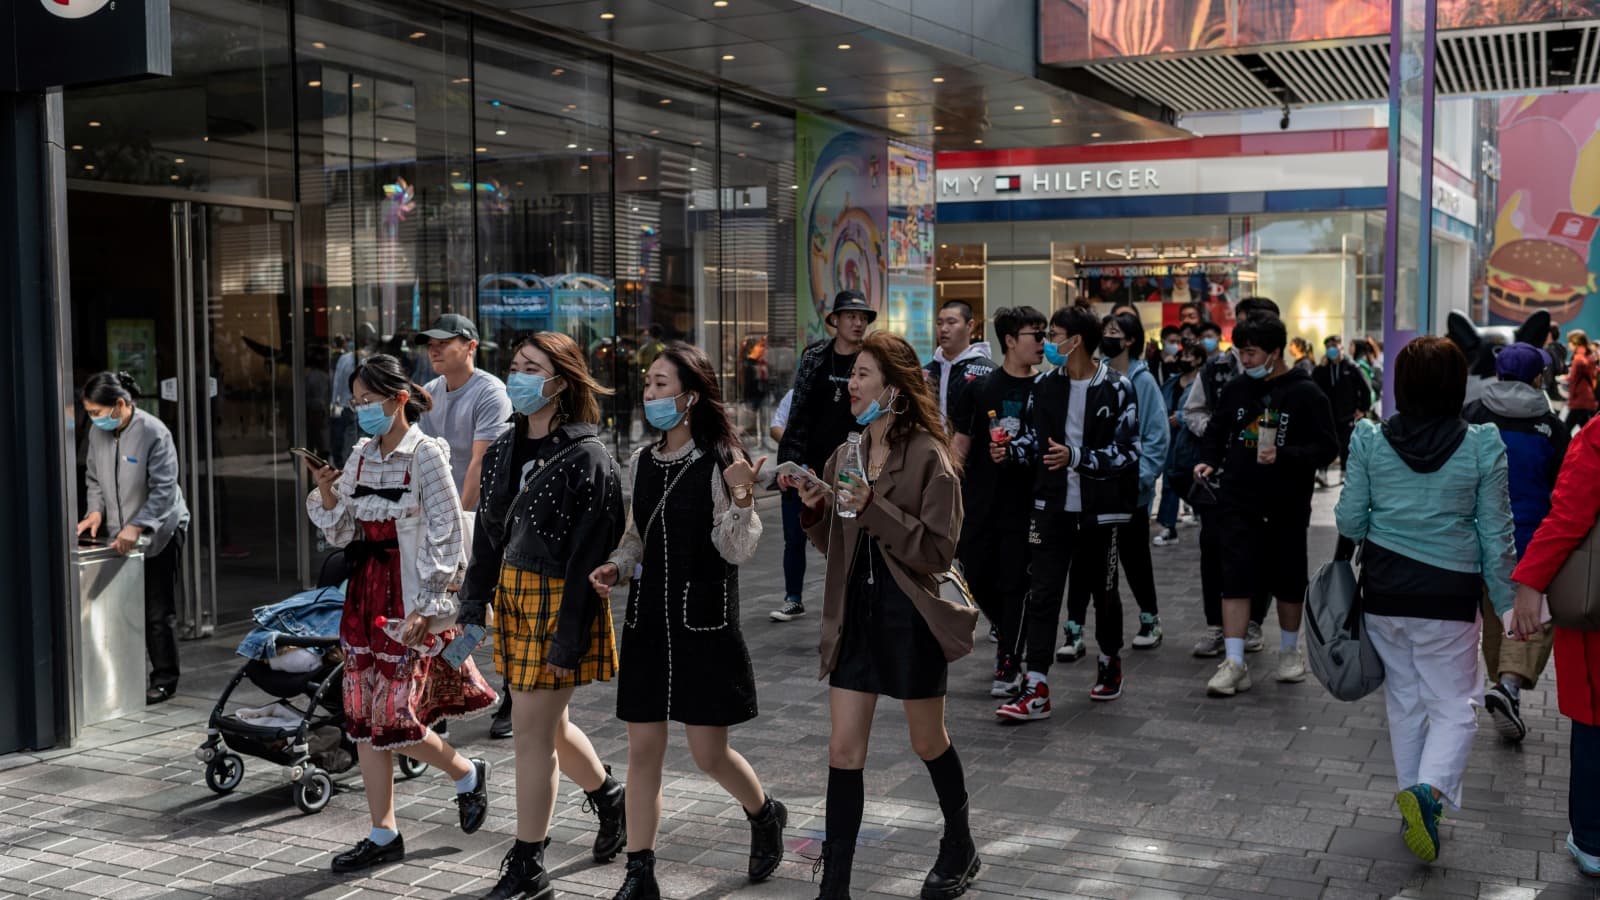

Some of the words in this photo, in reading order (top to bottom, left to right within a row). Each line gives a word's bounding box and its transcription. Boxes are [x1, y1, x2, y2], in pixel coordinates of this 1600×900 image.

[1033, 168, 1160, 191] HILFIGER
[1118, 264, 1168, 277] TOGETHER
[1277, 412, 1290, 447] GUCCI
